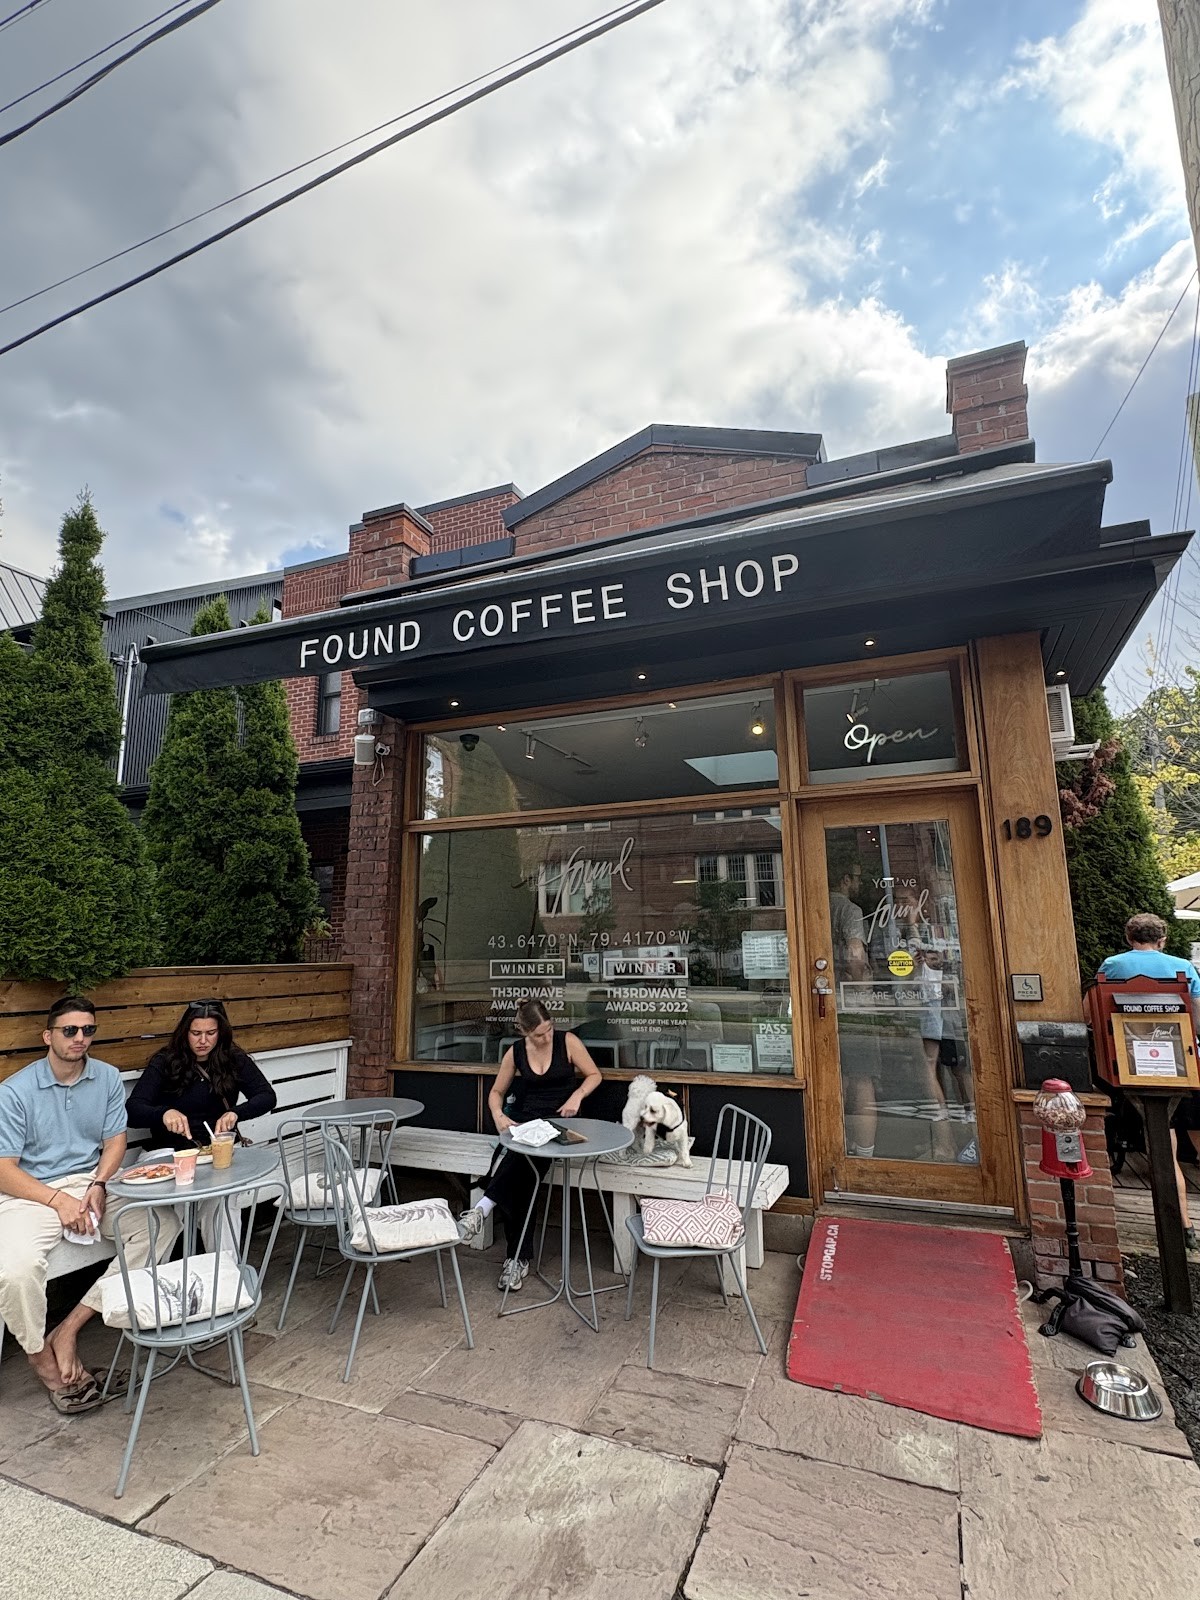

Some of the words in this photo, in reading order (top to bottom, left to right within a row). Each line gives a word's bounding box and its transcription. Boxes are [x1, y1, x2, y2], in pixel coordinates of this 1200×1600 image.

[300, 620, 420, 668] FOUND
[452, 583, 627, 641] COFFEE
[666, 553, 799, 609] SHOP
[844, 724, 938, 763] Open
[1003, 814, 1053, 840] 189
[488, 933, 578, 948] 43.6470°N
[590, 930, 690, 947] 79.4170°W
[891, 937, 907, 948] Us
[500, 963, 555, 974] WINNER
[615, 962, 676, 974] WINNER
[490, 987, 563, 998] TH3RDWAVE
[606, 987, 687, 999] TH3RDWAVE
[871, 991, 889, 1000] ARE
[541, 1001, 565, 1011] 022
[605, 1002, 656, 1012] AWARDS
[659, 1002, 688, 1013] 2022
[1164, 1005, 1180, 1013] SHOP
[759, 1023, 788, 1034] PASS
[820, 1225, 839, 1280] STOPGAP.CA
